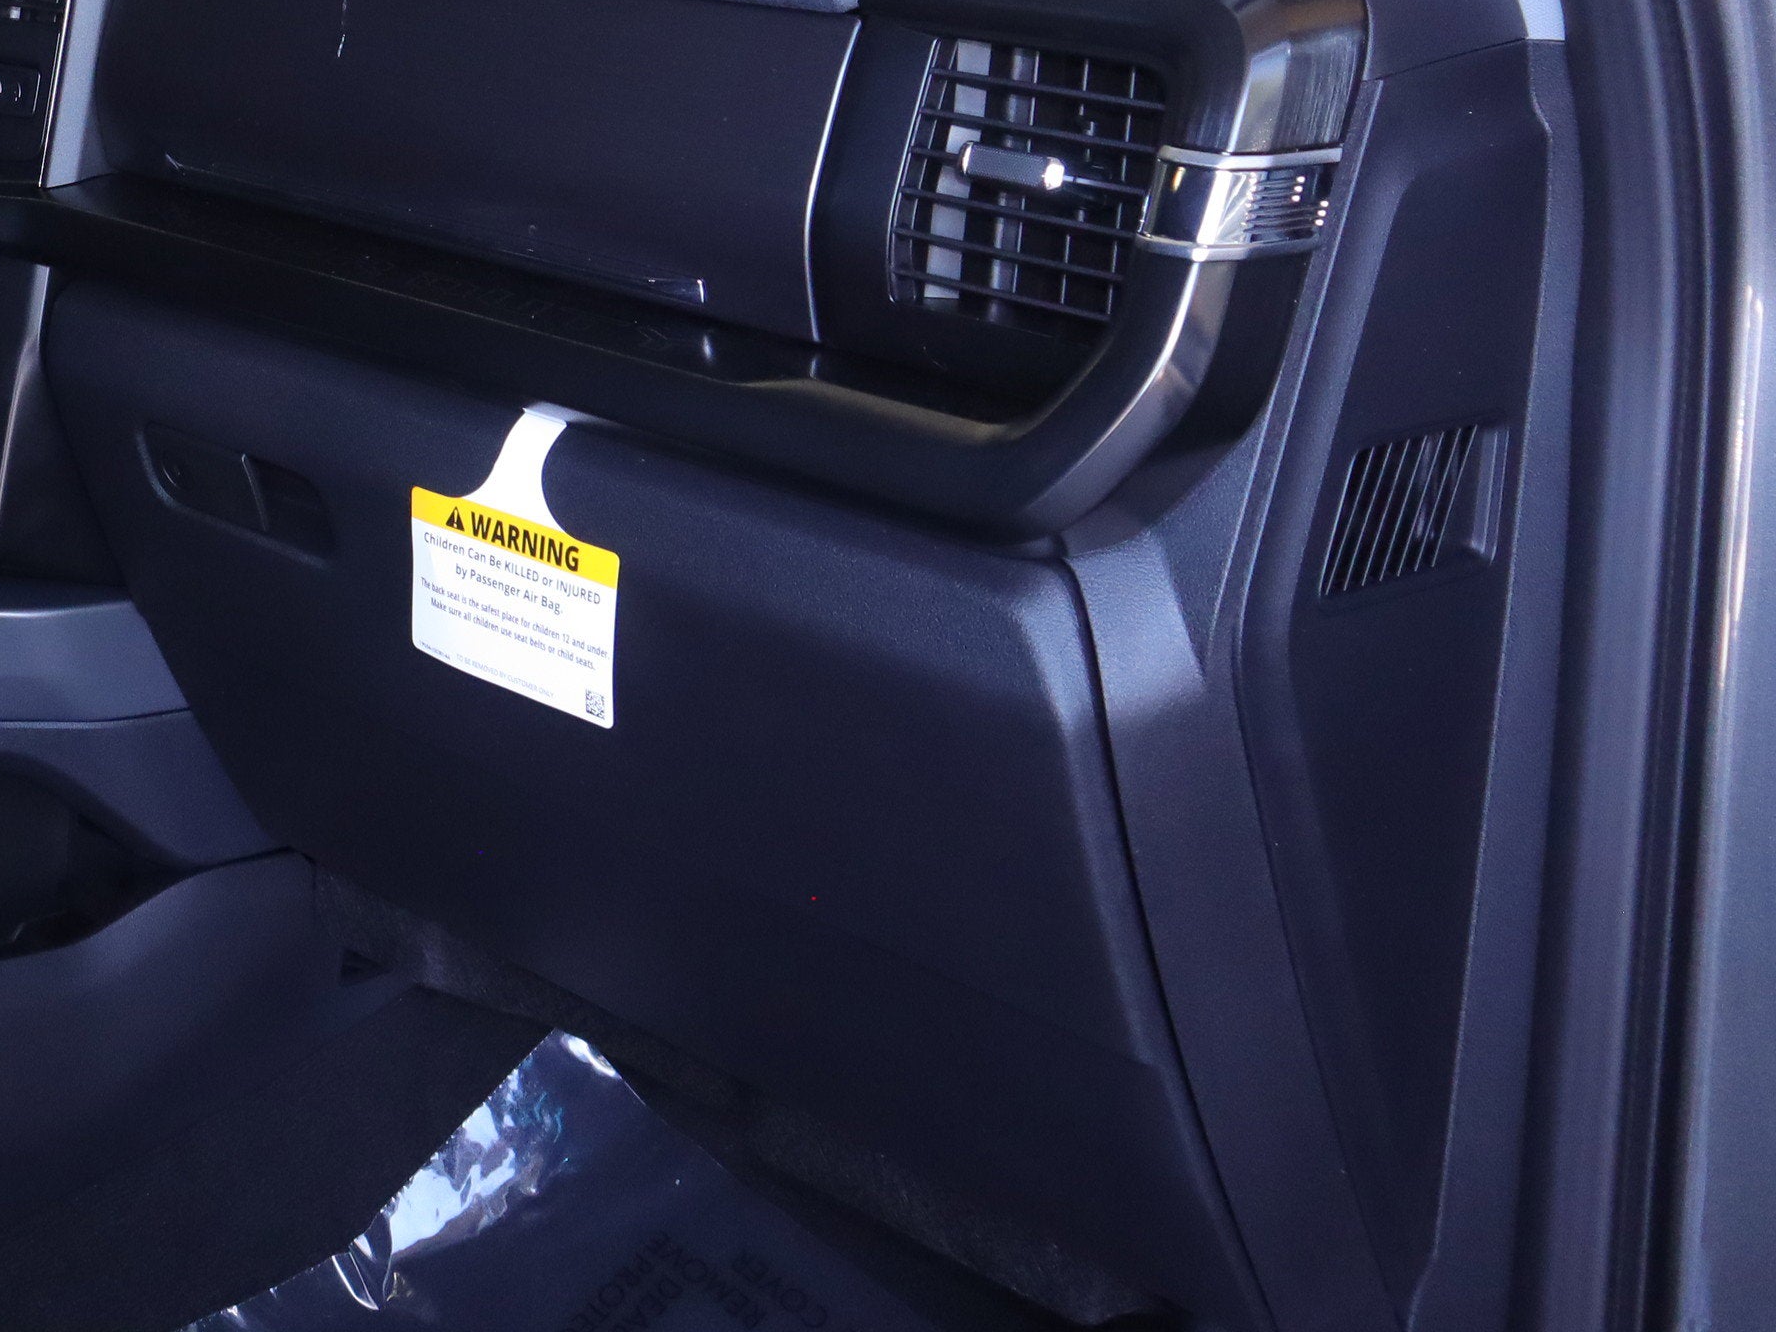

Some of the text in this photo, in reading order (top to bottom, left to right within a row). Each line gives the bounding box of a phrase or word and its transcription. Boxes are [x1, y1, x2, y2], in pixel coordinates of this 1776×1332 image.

[423, 531, 601, 605] Children Can Be KILLED or INJURED
[470, 511, 580, 572] WARNING
[421, 576, 611, 660] The back seat is the safest place for children 12 and under.
[455, 563, 563, 616] by Passenger Air Bag.
[430, 597, 597, 671] Make sure all children use seat belts or child seats.
[456, 653, 464, 663] TO
[464, 656, 472, 665] BE
[472, 659, 499, 677] REMOVED
[499, 669, 507, 679] BY
[507, 672, 538, 693] CUSTOMER
[730, 1248, 828, 1329] COVER
